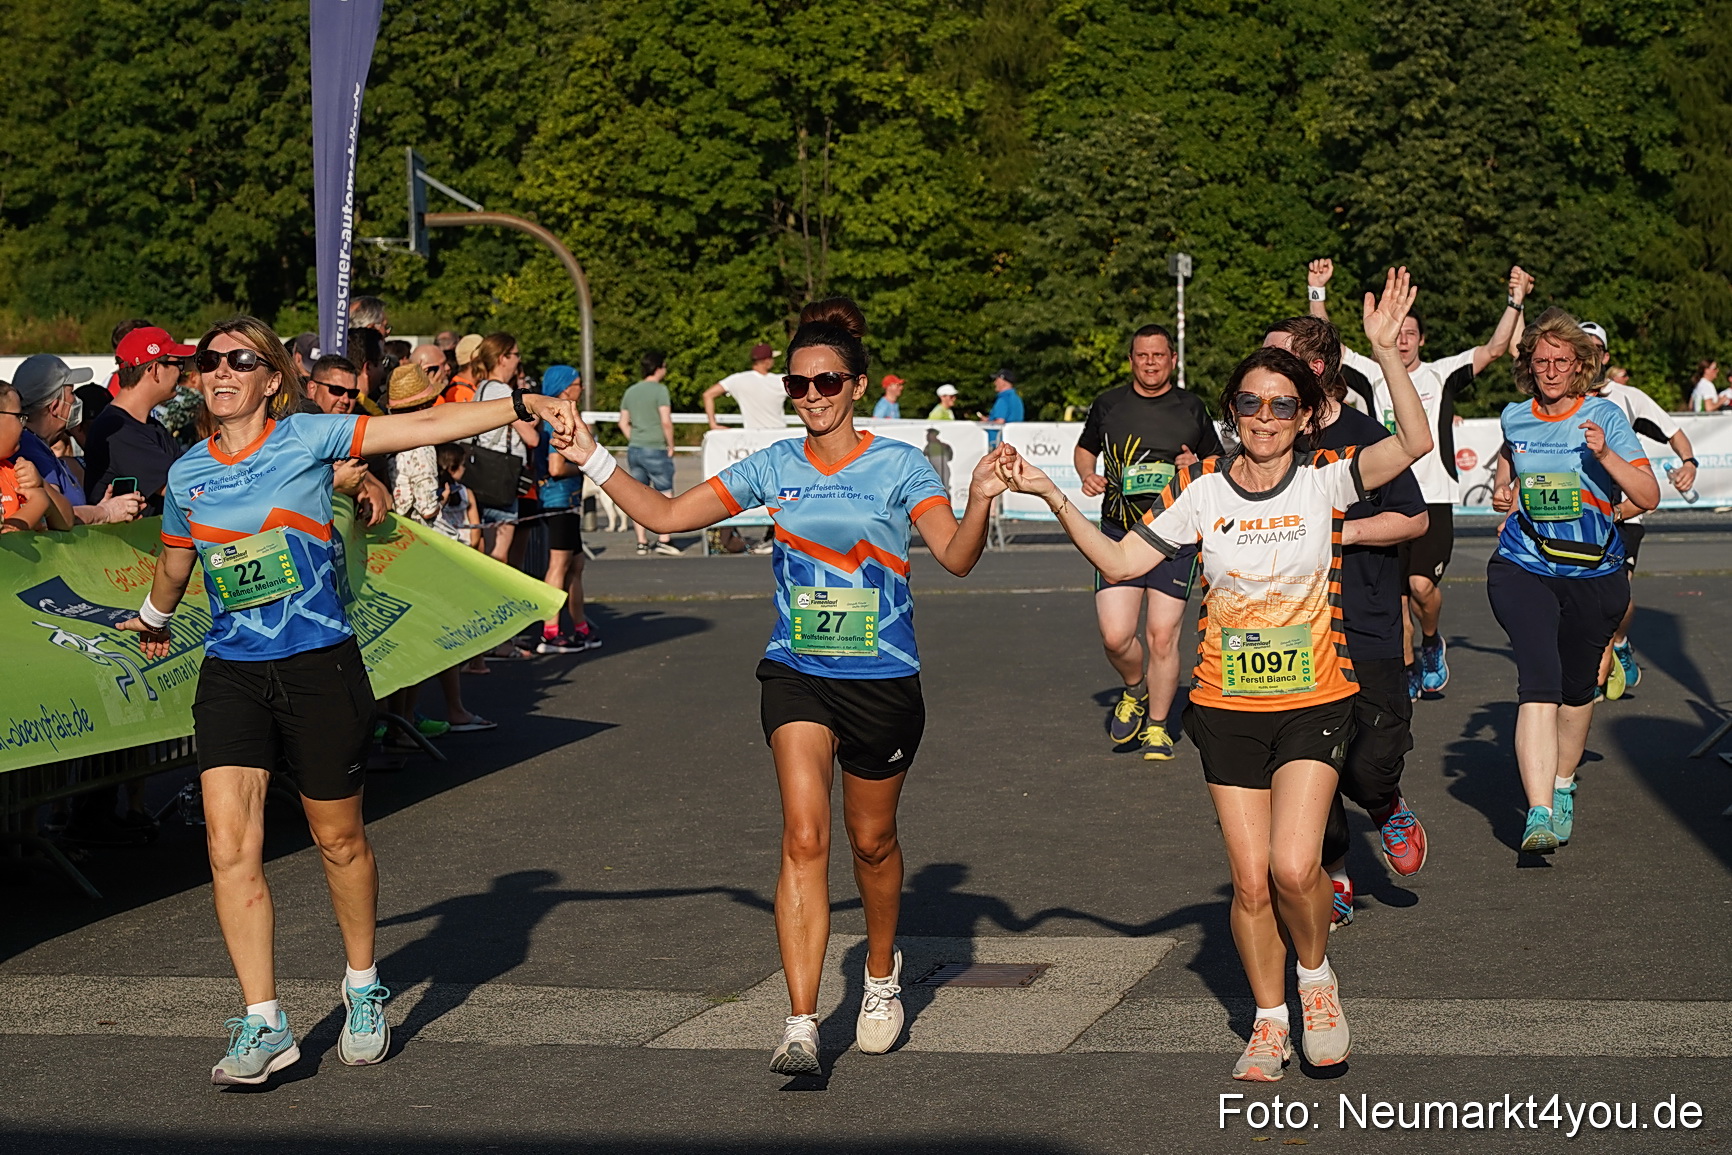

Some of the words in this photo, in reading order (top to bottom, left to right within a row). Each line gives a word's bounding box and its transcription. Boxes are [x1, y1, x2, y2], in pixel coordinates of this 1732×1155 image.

[1026, 443, 1061, 456] NOW
[1136, 473, 1163, 485] 672
[1540, 489, 1560, 505] 14
[1571, 490, 1580, 512] 2022
[1237, 524, 1307, 545] DYNAMICS
[234, 560, 265, 586] 22
[279, 554, 296, 584] 2022
[216, 577, 230, 598] RUN
[255, 576, 286, 592] Melanie
[794, 616, 803, 640] RUN
[817, 610, 848, 633] 27
[865, 615, 875, 647] 2022
[801, 633, 836, 641] Wolfsteiner
[837, 633, 865, 642] Josefine
[1226, 654, 1236, 686] WALK
[1236, 649, 1298, 674] 1097
[1301, 651, 1311, 682] 2022
[157, 656, 201, 692] neumarkt
[1240, 675, 1265, 683] Ferstl
[1266, 674, 1297, 683] Bianca
